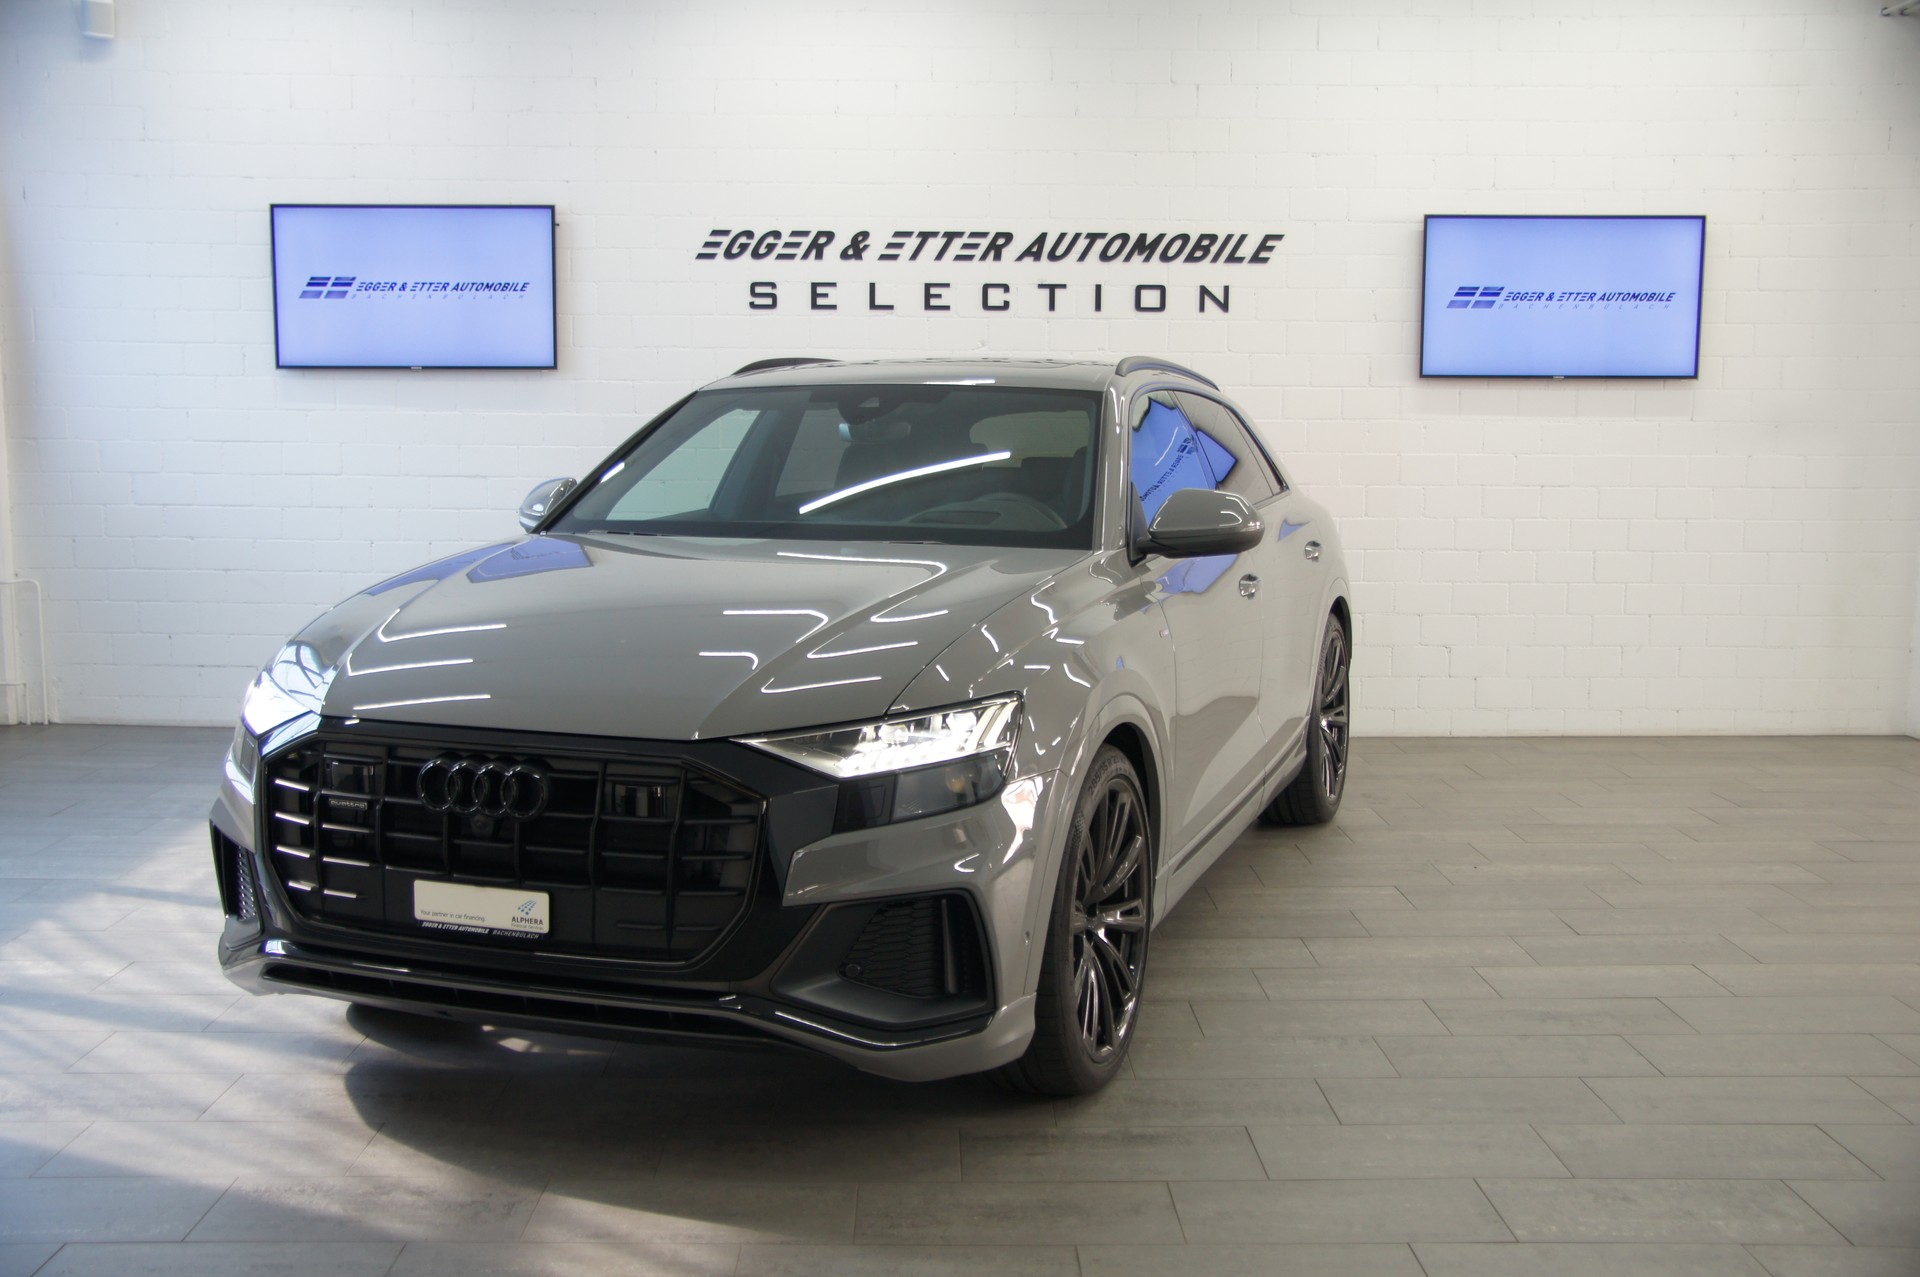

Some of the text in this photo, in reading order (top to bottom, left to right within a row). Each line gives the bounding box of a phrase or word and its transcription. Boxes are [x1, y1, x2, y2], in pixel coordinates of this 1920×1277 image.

[695, 229, 1285, 264] EGGER & ETTER AUTOMOBILE
[356, 282, 530, 292] EGGER & ETTER AUTOMOBILE
[748, 281, 1230, 313] SELECTION
[1503, 291, 1677, 302] EGGER & ETTER AUTOMOBILE
[511, 916, 544, 925] ALPHERA
[458, 925, 490, 934] AUTOMOBILE
